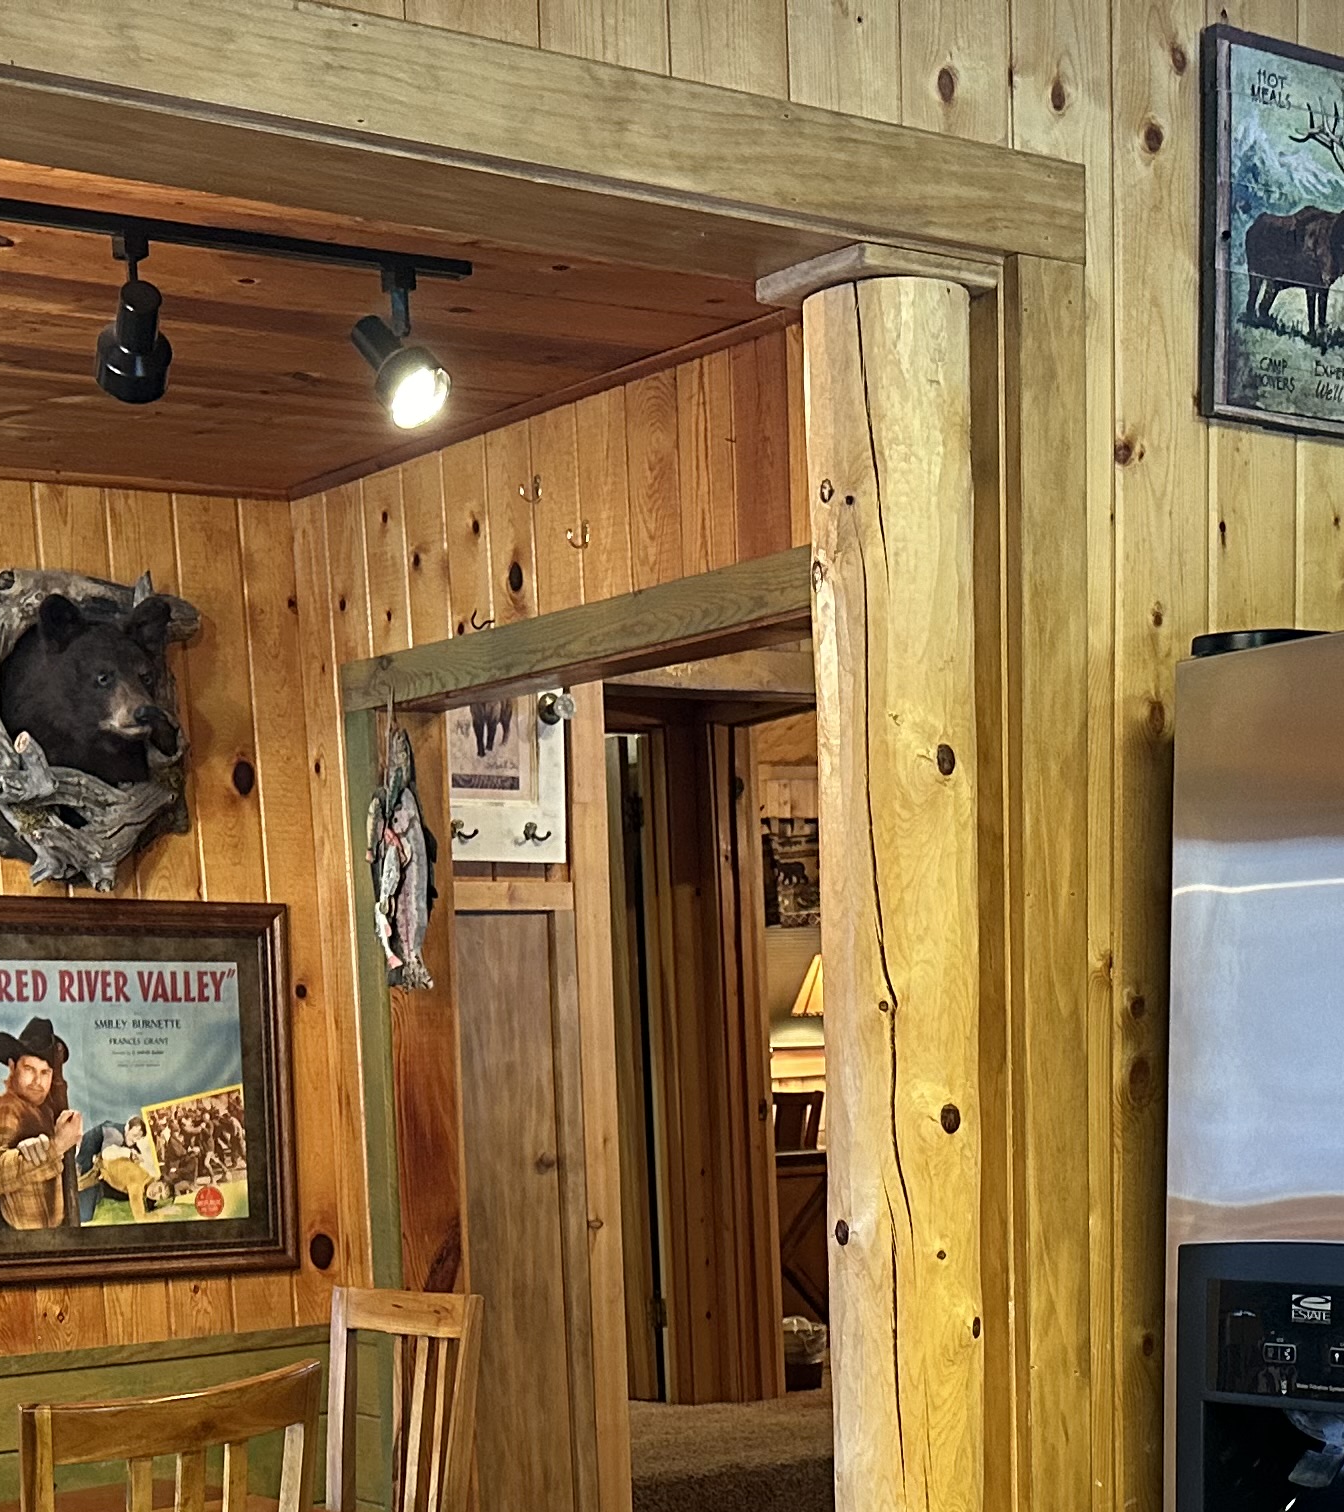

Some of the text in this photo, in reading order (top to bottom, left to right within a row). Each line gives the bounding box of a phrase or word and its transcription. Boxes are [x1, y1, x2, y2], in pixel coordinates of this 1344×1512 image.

[1257, 68, 1288, 89] HOT
[1250, 83, 1292, 110] MEALS
[1315, 379, 1344, 403] We'll
[58, 969, 130, 1003] RIVER
[137, 968, 236, 1003] VALLEY"
[94, 1019, 181, 1030] SMILEY BURNETTE
[1291, 1309, 1331, 1322] ESTATE
